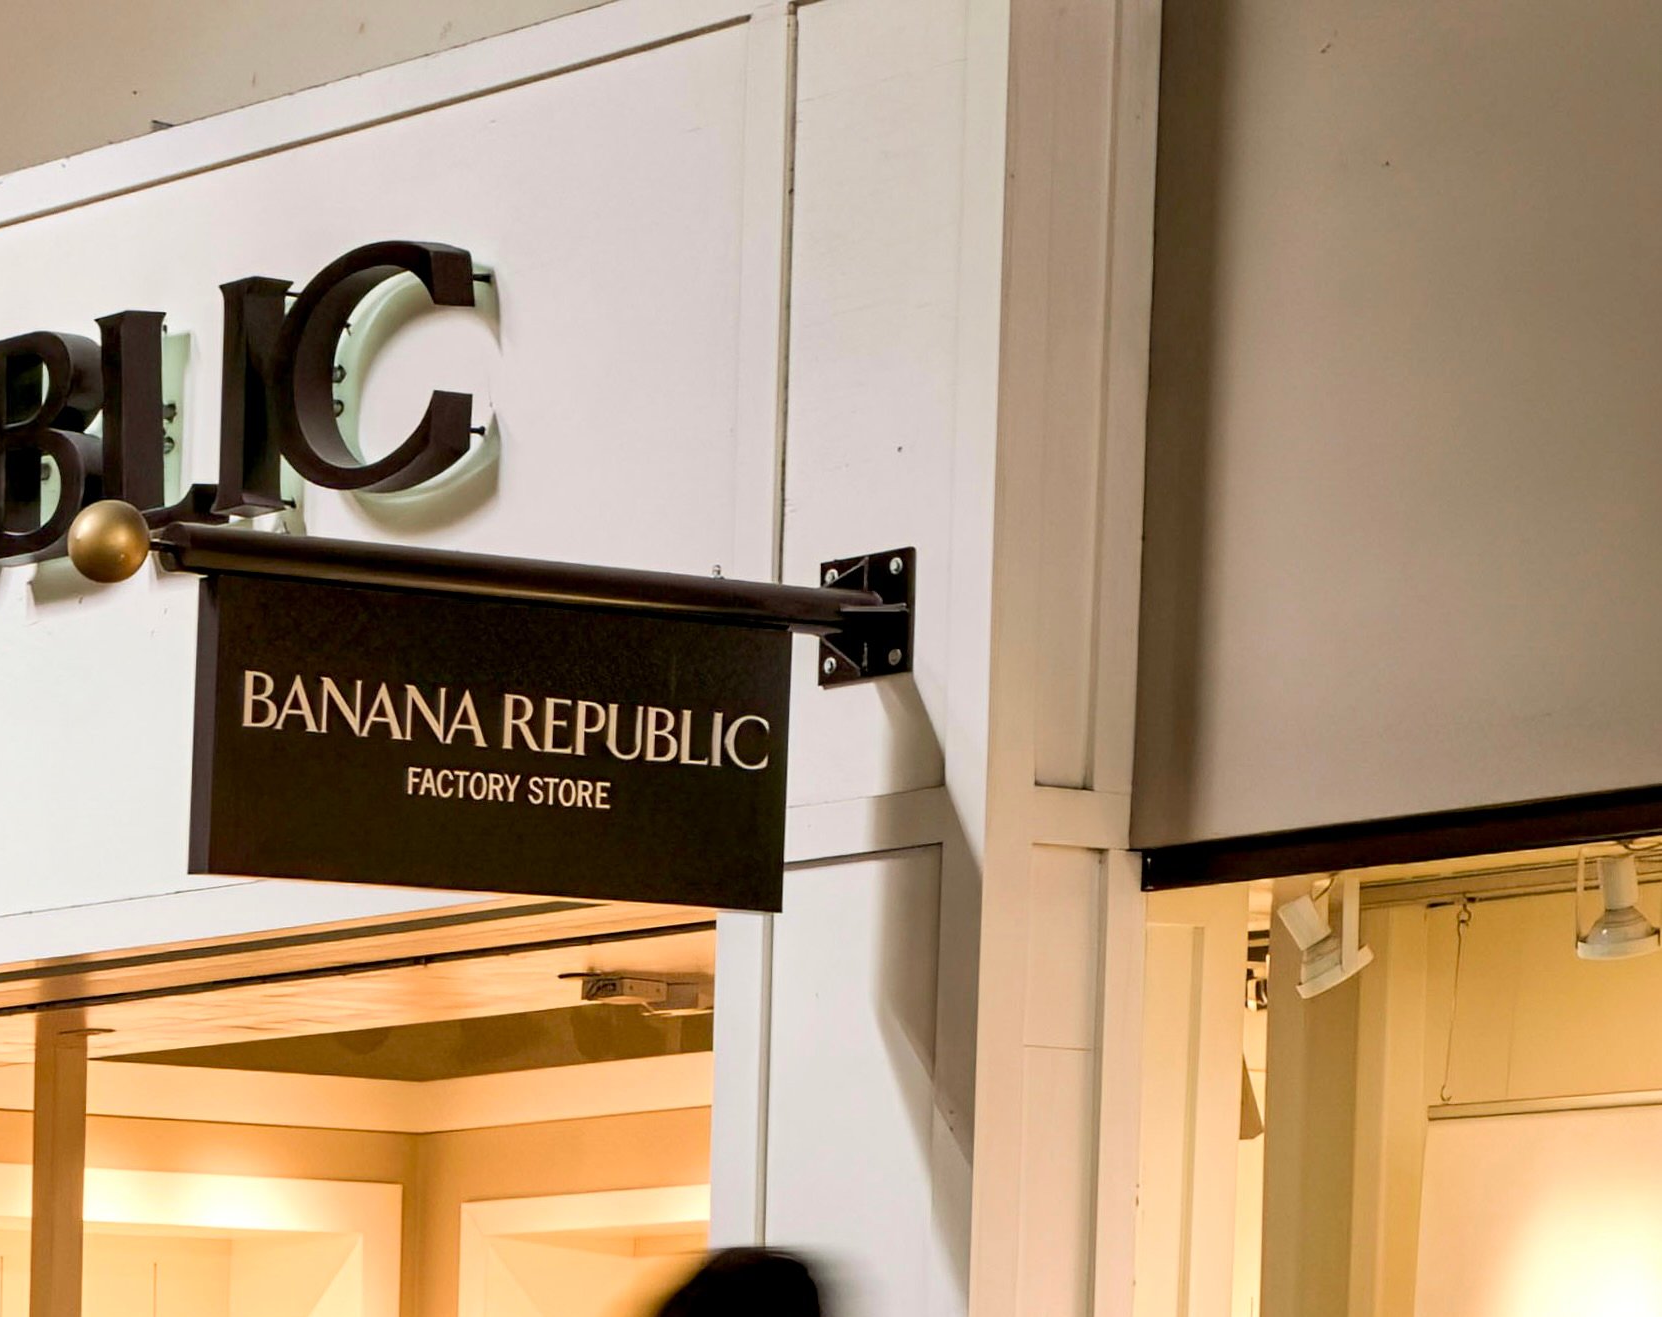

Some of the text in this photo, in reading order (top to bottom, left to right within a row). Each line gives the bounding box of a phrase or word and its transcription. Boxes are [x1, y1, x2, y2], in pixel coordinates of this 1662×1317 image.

[241, 669, 771, 772] BANANA REPUBLIC
[406, 766, 612, 810] FACTORY STORE
